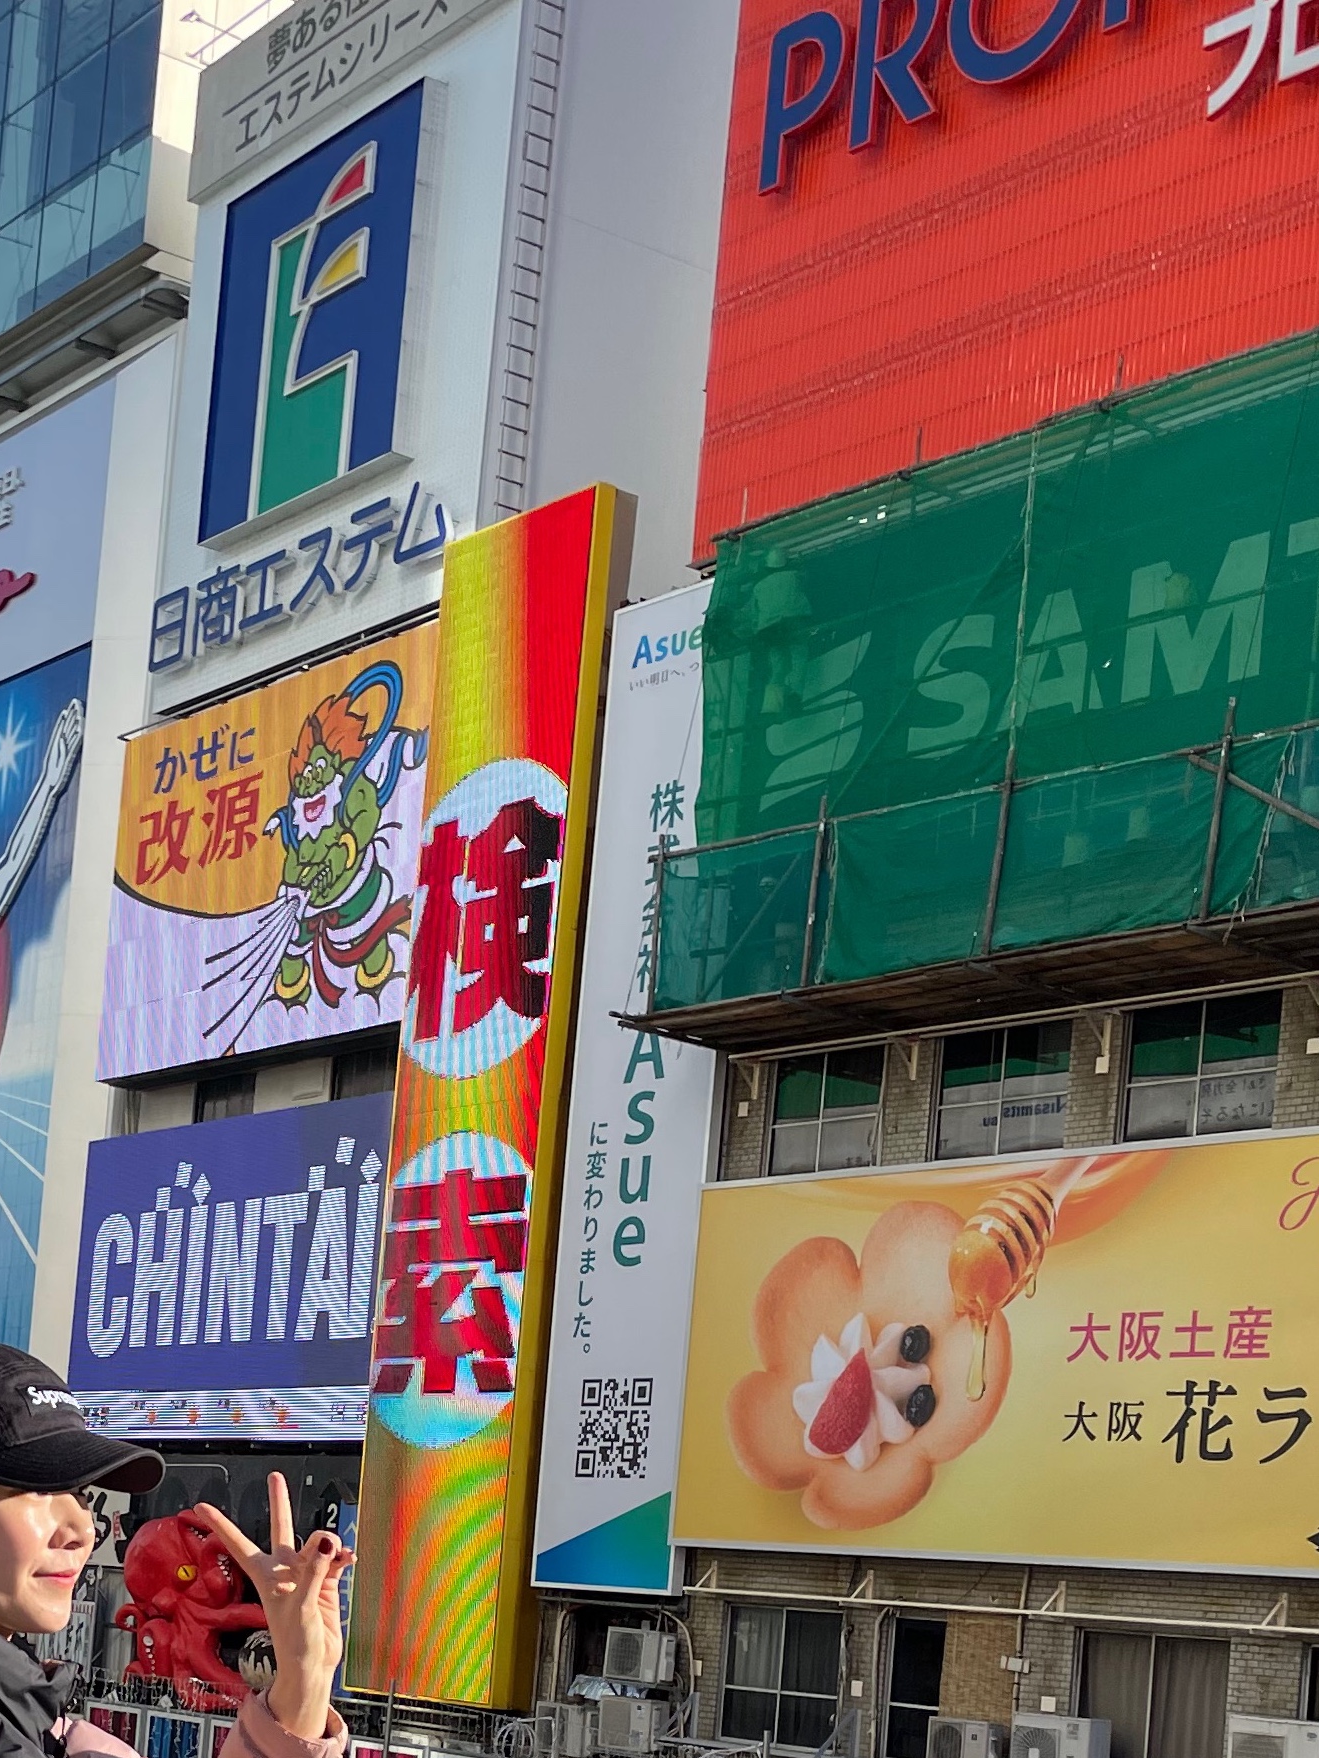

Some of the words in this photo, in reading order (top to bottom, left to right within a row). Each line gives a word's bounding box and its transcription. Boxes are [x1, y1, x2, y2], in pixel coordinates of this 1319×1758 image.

[758, 0, 1128, 197] PRO
[149, 481, 453, 674] 日商エステム
[631, 624, 703, 669] Asue
[905, 516, 1319, 762] SAM
[134, 773, 268, 886] 改源
[153, 722, 256, 796] かぜに
[572, 1118, 611, 1354] に変わりました。
[612, 1030, 666, 1268] Asue
[87, 1152, 382, 1359] CHINTAI
[1066, 1305, 1273, 1363] 大阪土産
[1062, 1400, 1146, 1443] 大阪
[1160, 1379, 1314, 1464] 花ラ
